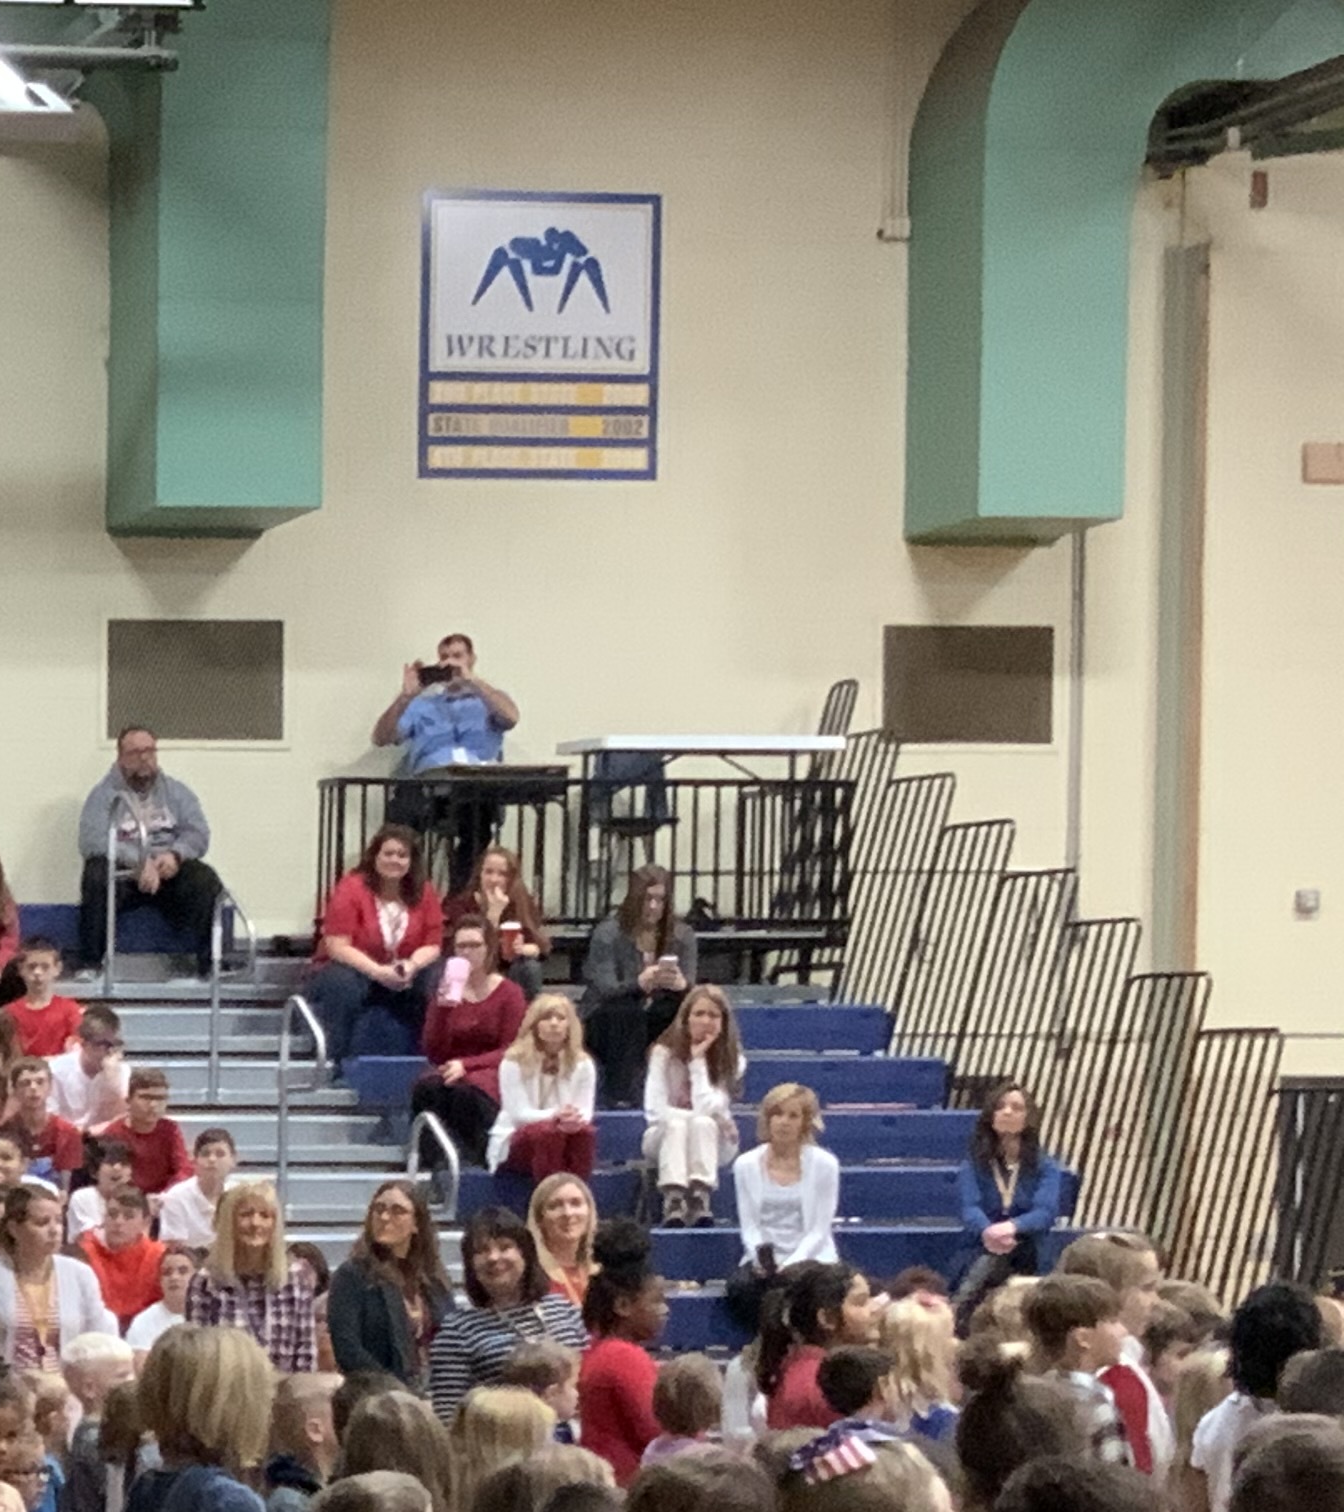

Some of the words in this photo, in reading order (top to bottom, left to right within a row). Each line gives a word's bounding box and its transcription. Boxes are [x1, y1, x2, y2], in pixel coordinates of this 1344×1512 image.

[445, 333, 637, 362] WRESTLING
[433, 416, 482, 434] STATE
[602, 418, 644, 437] 2002
